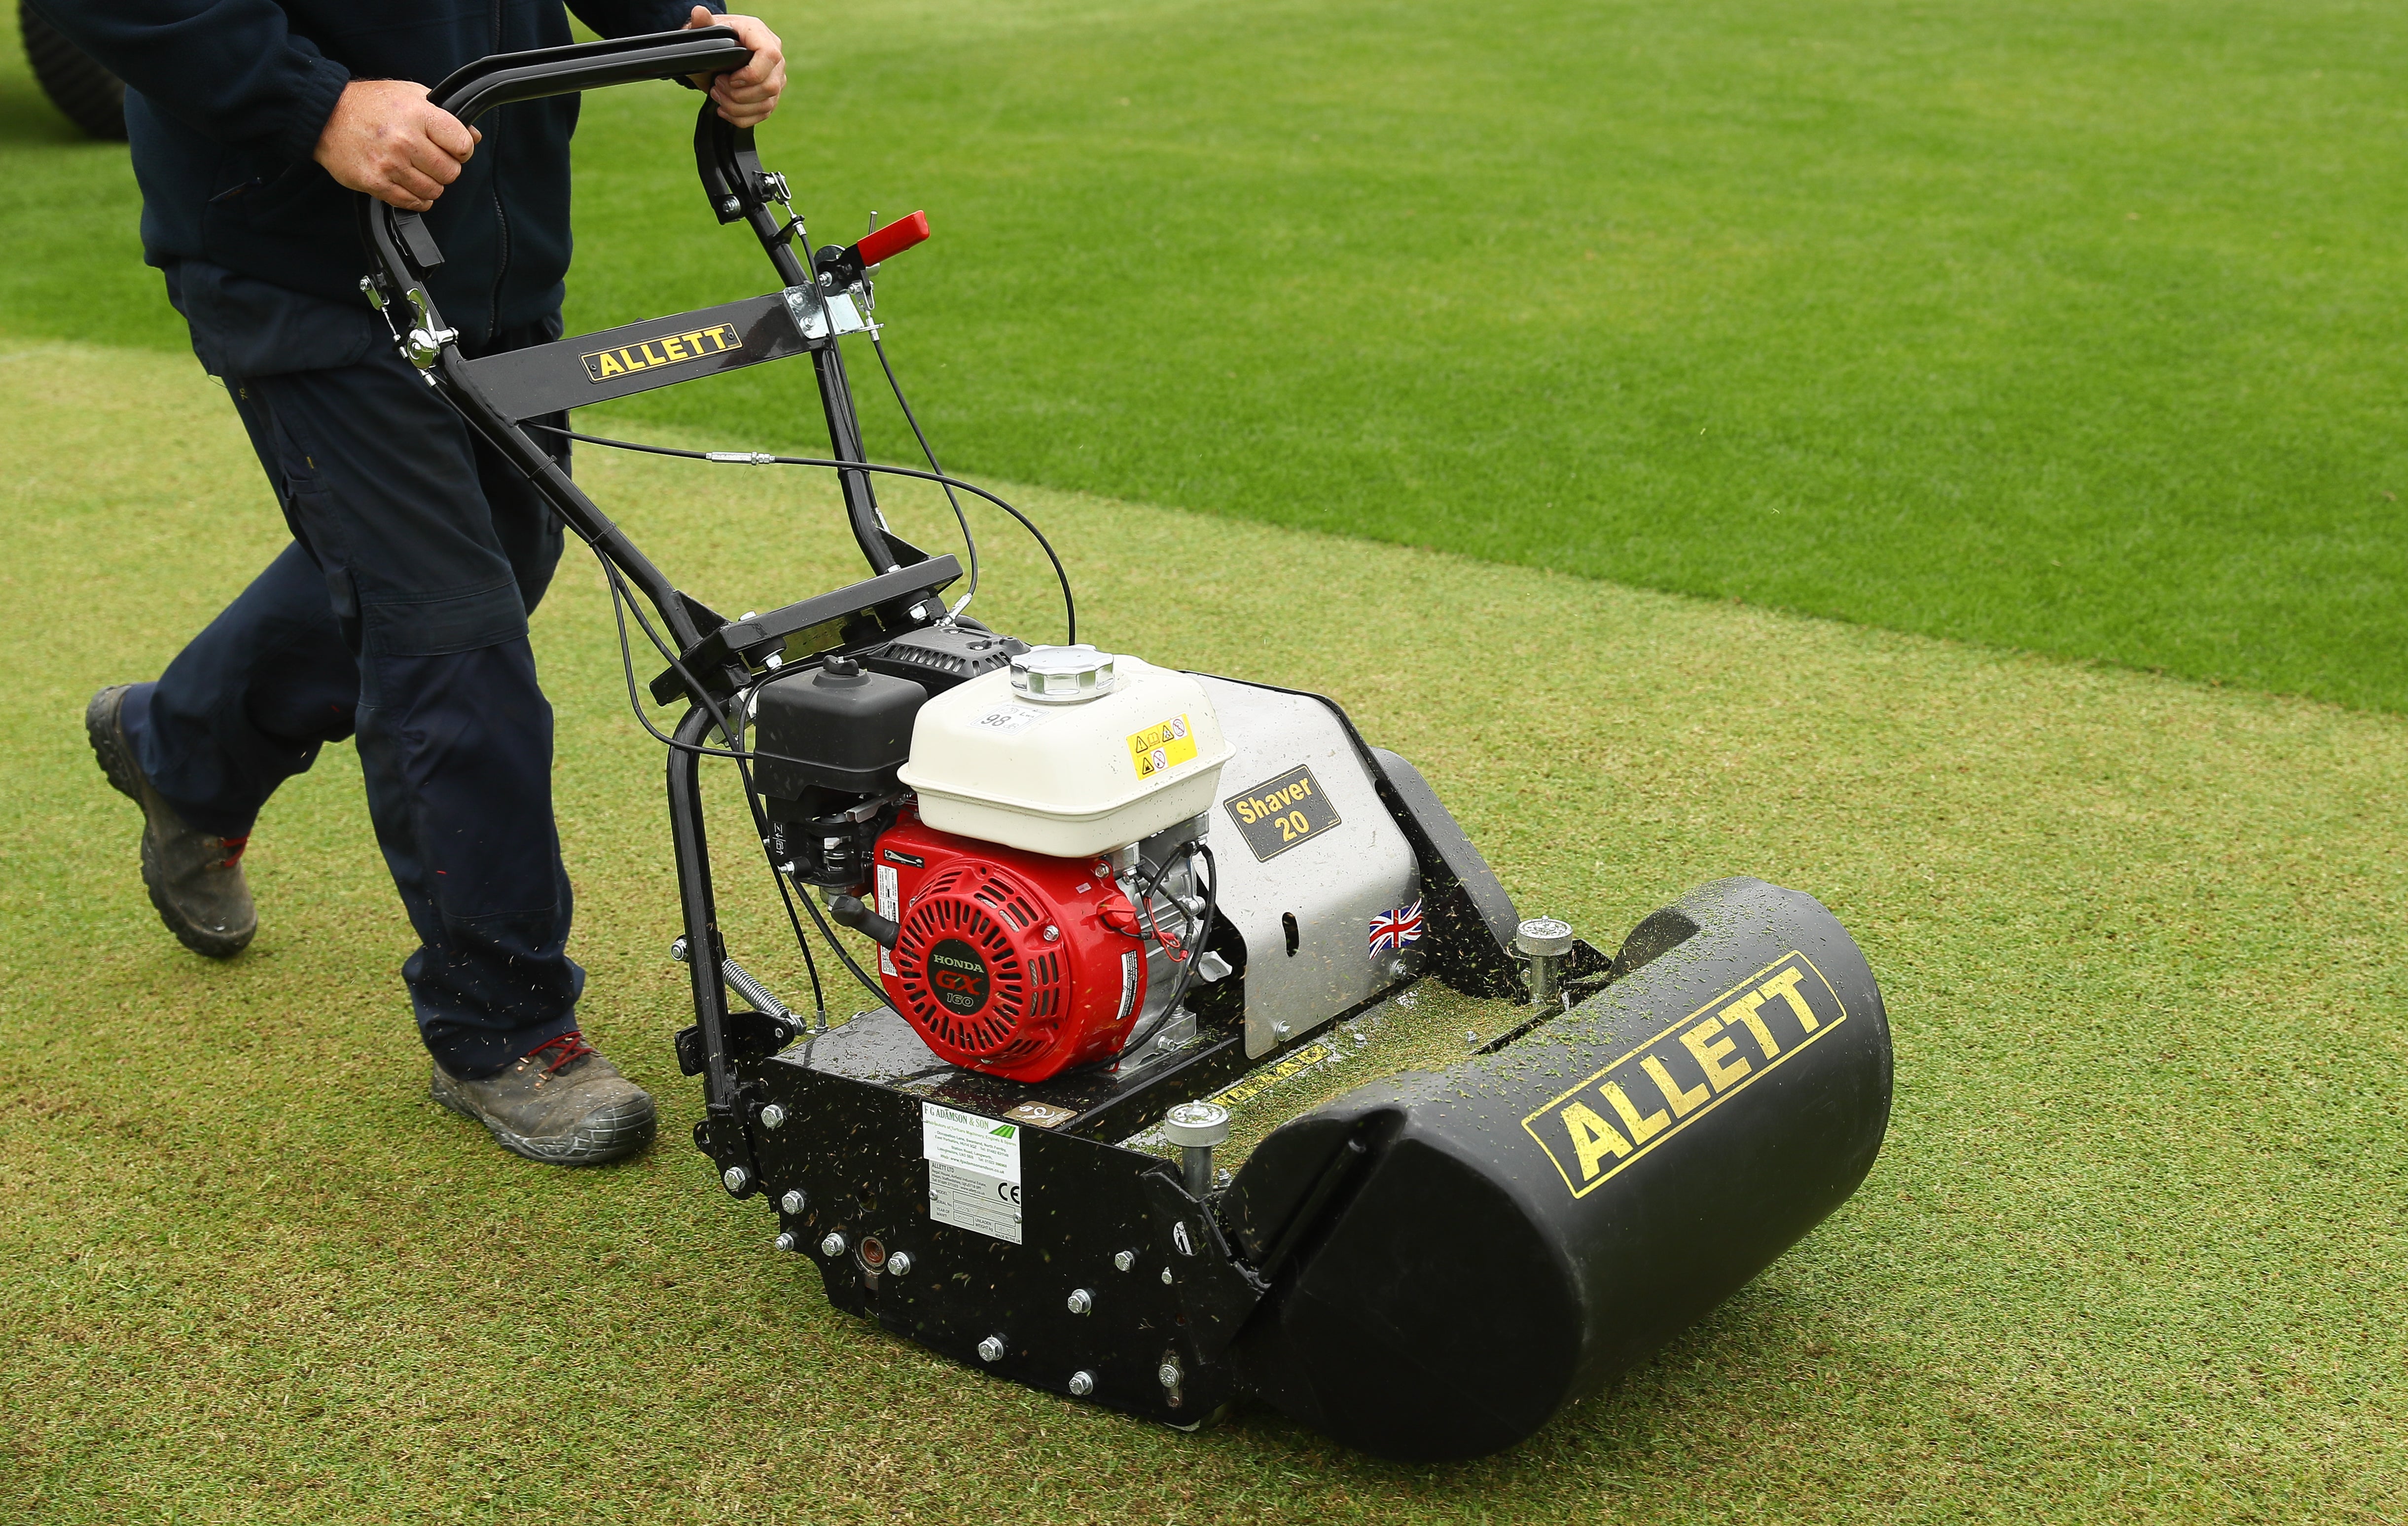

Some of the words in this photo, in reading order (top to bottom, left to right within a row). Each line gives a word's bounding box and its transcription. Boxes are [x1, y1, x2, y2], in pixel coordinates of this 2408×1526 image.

[600, 327, 726, 376] ALLETT
[981, 714, 1011, 726] 98
[1236, 777, 1312, 824] Shaver
[1274, 810, 1309, 842] 20
[934, 954, 984, 973] HONDA
[935, 970, 982, 995] GX
[947, 993, 973, 1007] 160
[1560, 965, 1820, 1181] ALLETT
[924, 1105, 929, 1114] F
[930, 1106, 934, 1116] G
[935, 1108, 968, 1125] ADAMSON
[969, 1117, 974, 1126] &
[975, 1118, 989, 1130] SON
[932, 1162, 946, 1171] ALLETT
[998, 1180, 1020, 1205] CE
